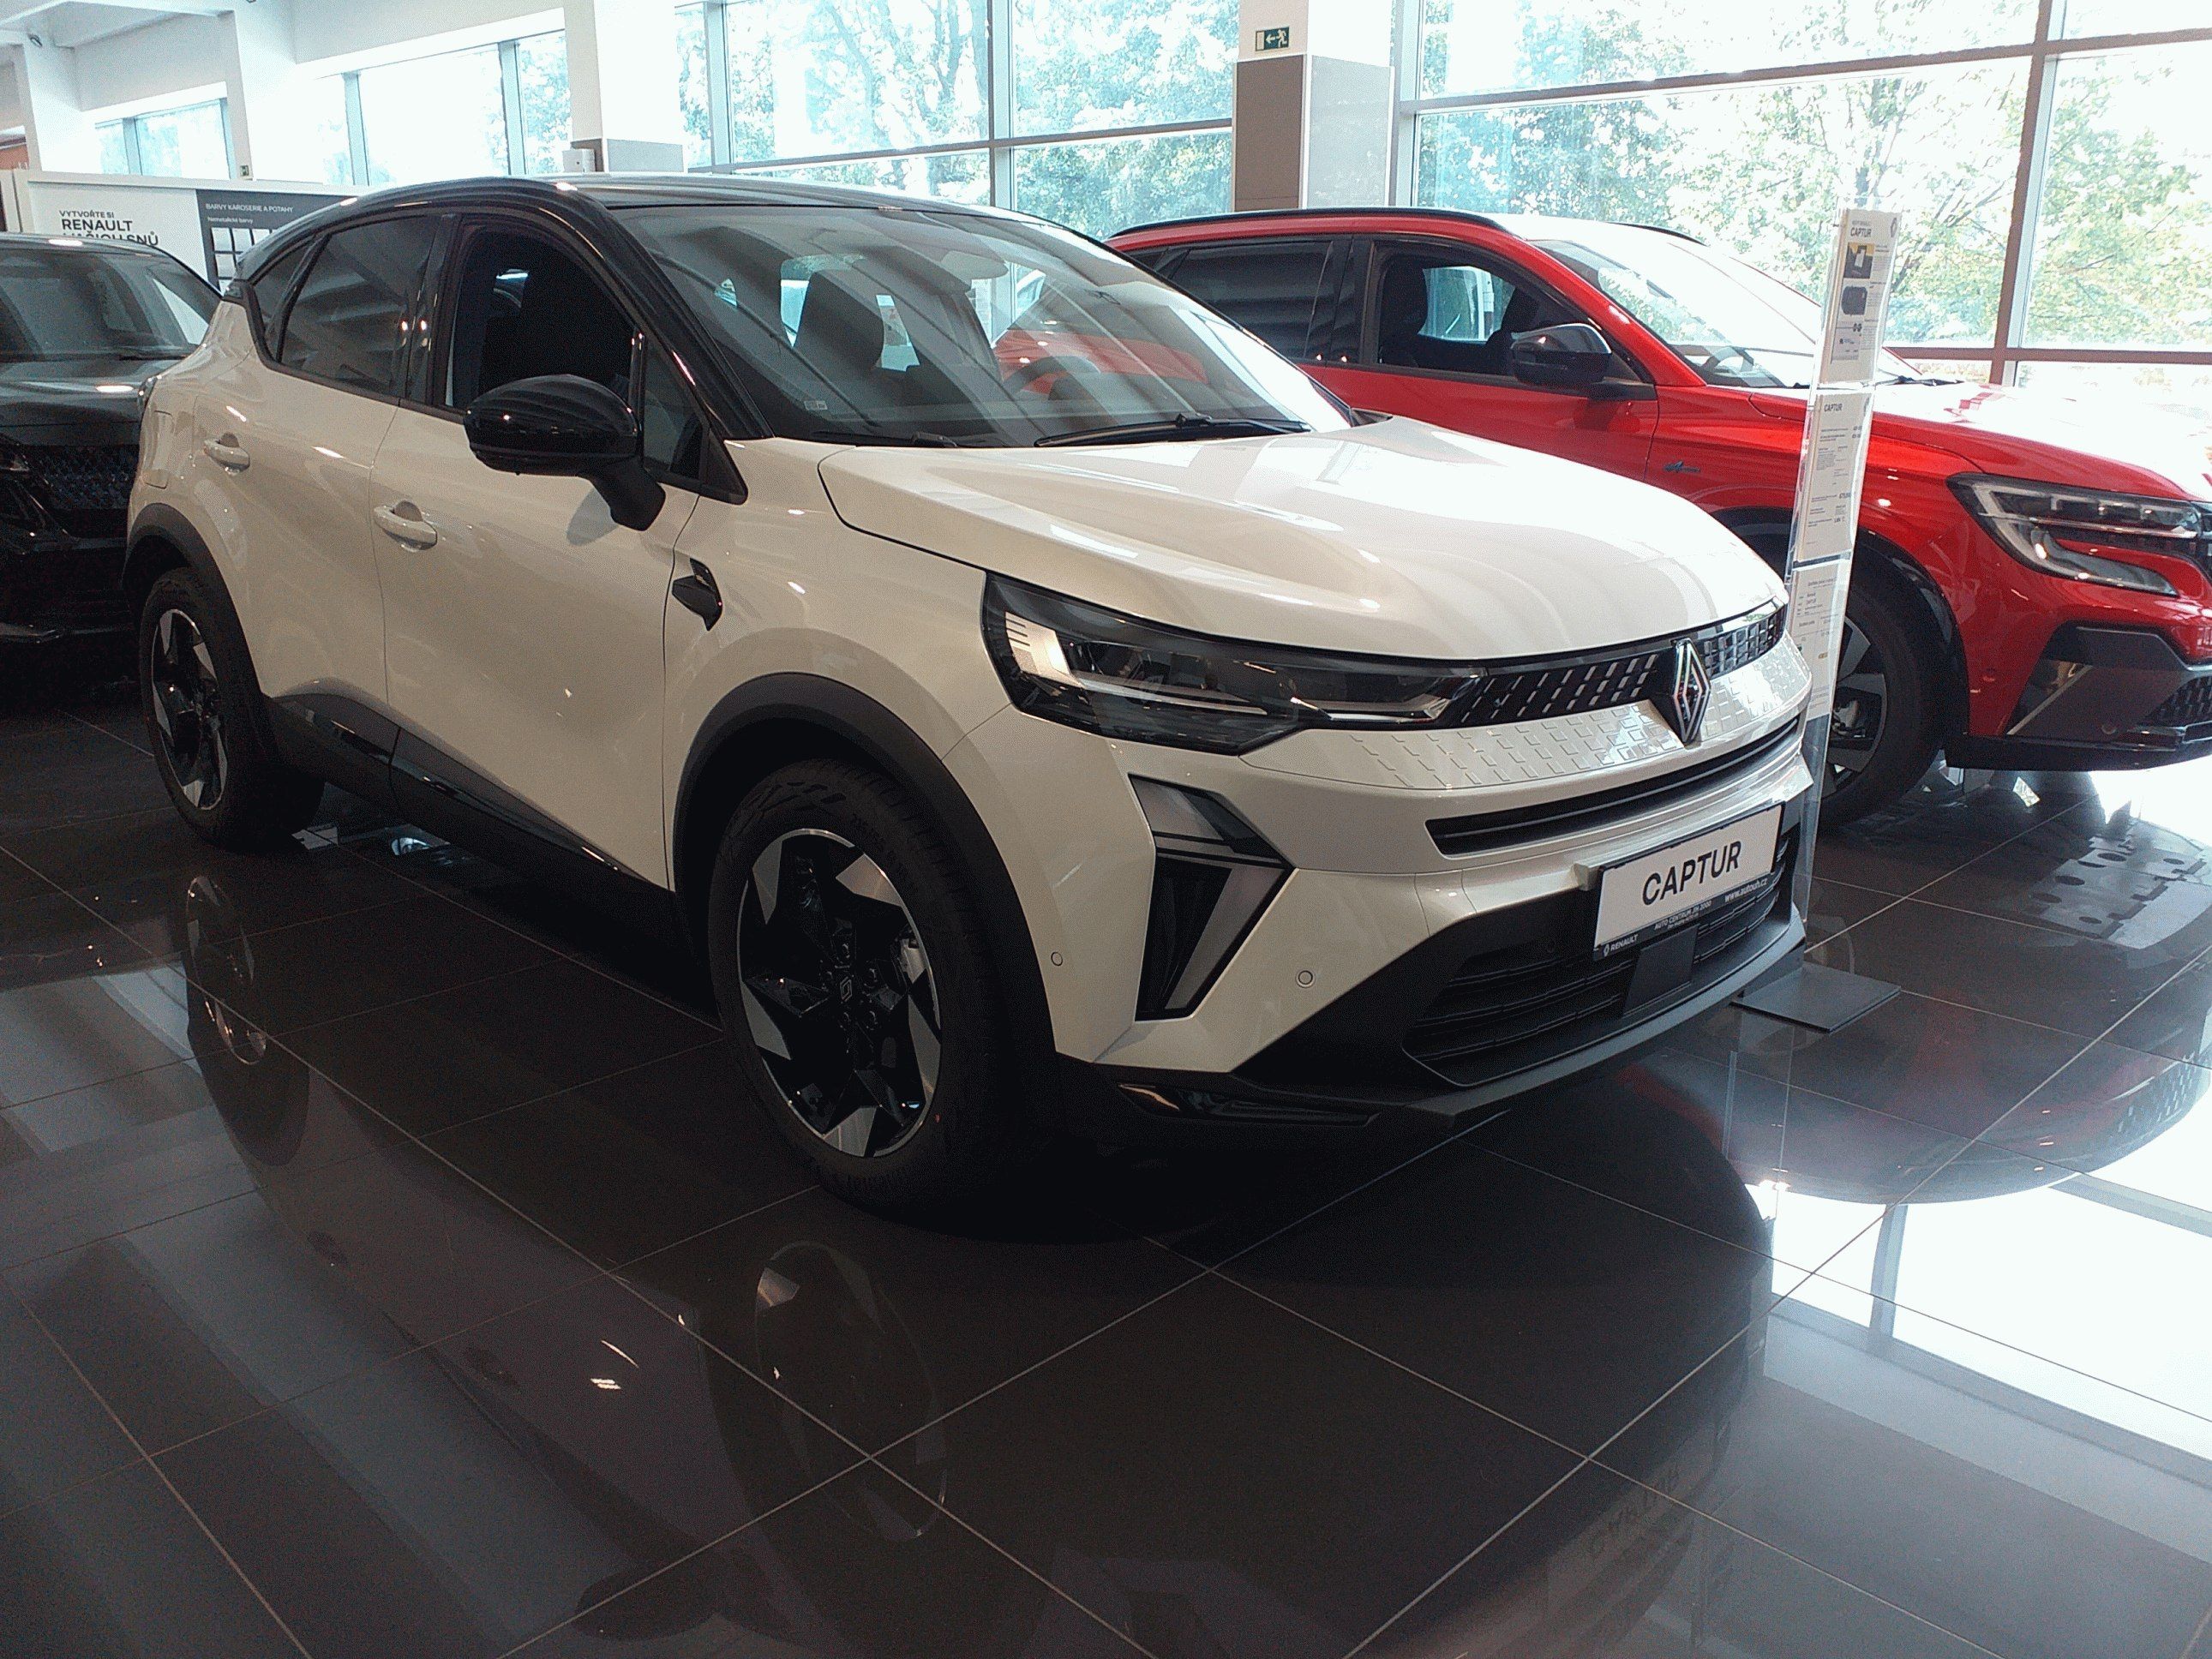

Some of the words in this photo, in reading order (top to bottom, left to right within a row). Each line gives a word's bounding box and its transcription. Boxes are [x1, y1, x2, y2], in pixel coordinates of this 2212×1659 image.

[59, 209, 105, 219] VYTVOŘTE
[228, 204, 262, 213] KAROSERIE
[62, 219, 133, 231] RENAULT
[1849, 226, 1872, 237] CAPTUR
[1824, 403, 1843, 412] CAPTUR
[1642, 841, 1741, 906] CAPTUR
[1654, 919, 1669, 931] AUTO
[1610, 934, 1639, 952] RENAULT
